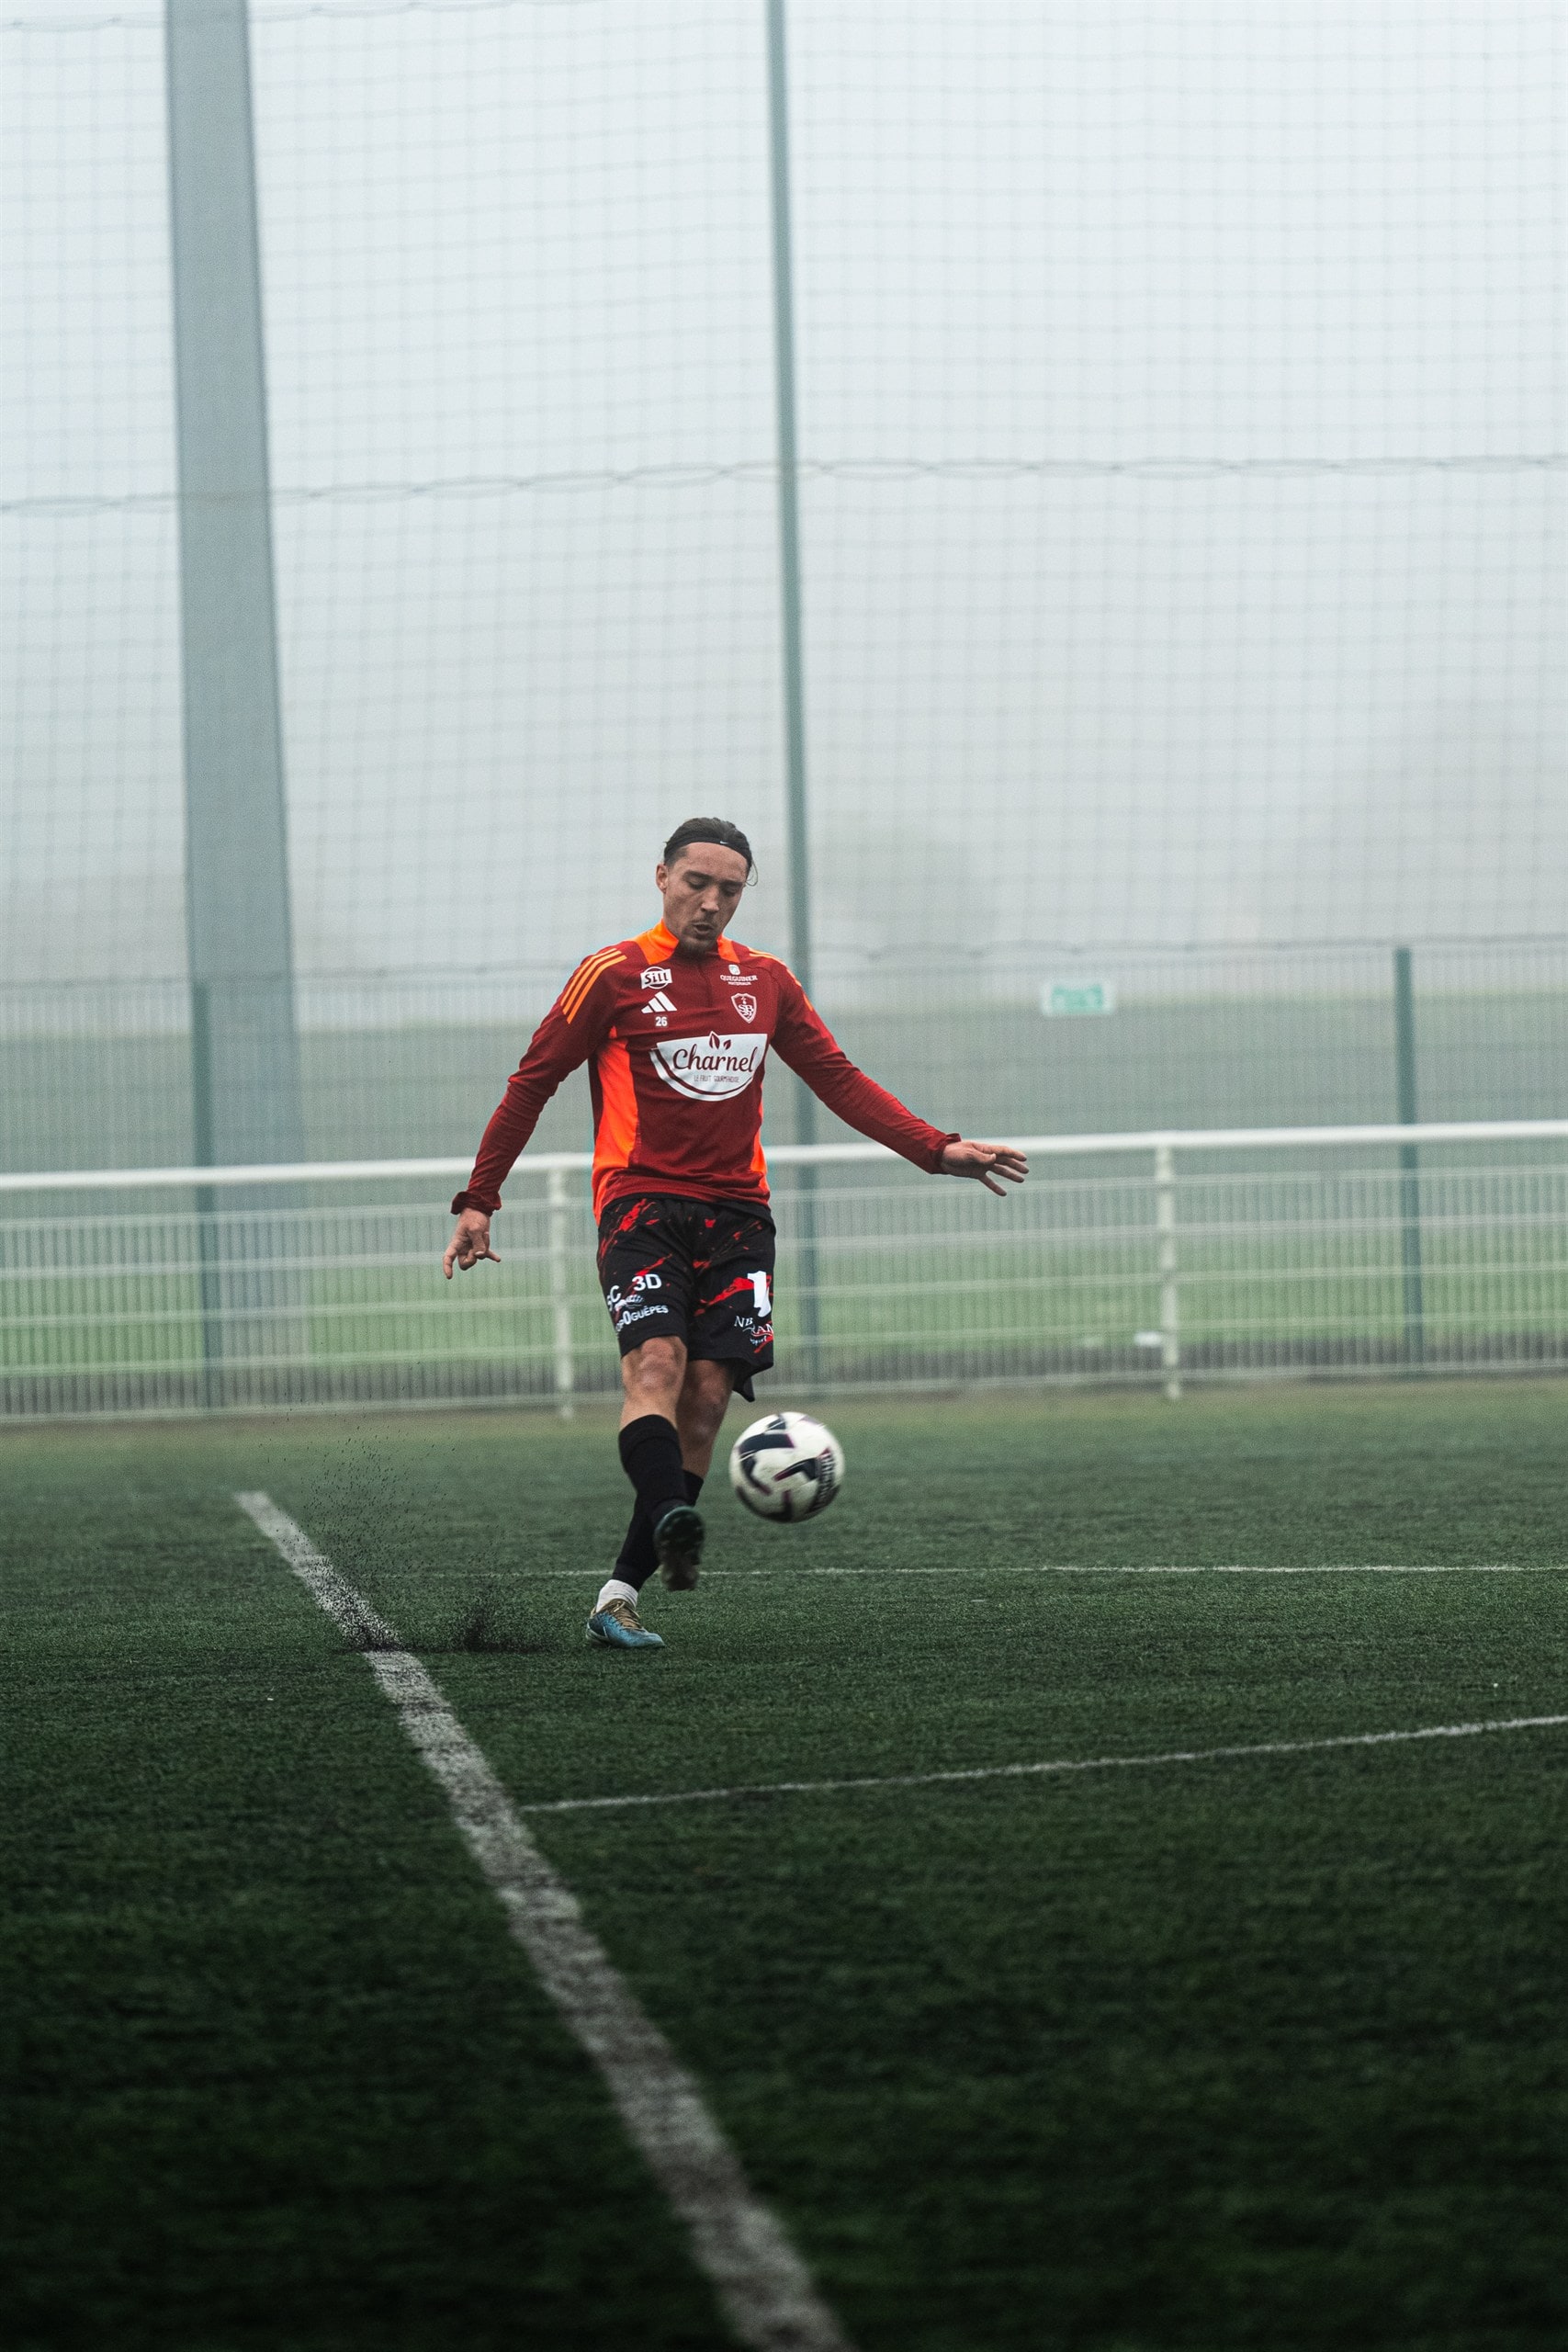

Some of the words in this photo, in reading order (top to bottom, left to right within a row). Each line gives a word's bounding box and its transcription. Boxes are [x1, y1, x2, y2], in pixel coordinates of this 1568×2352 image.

[644, 972, 669, 985] Sill
[655, 1016, 668, 1027] 26
[672, 1043, 758, 1073] Charnel
[631, 1273, 662, 1292] 3D
